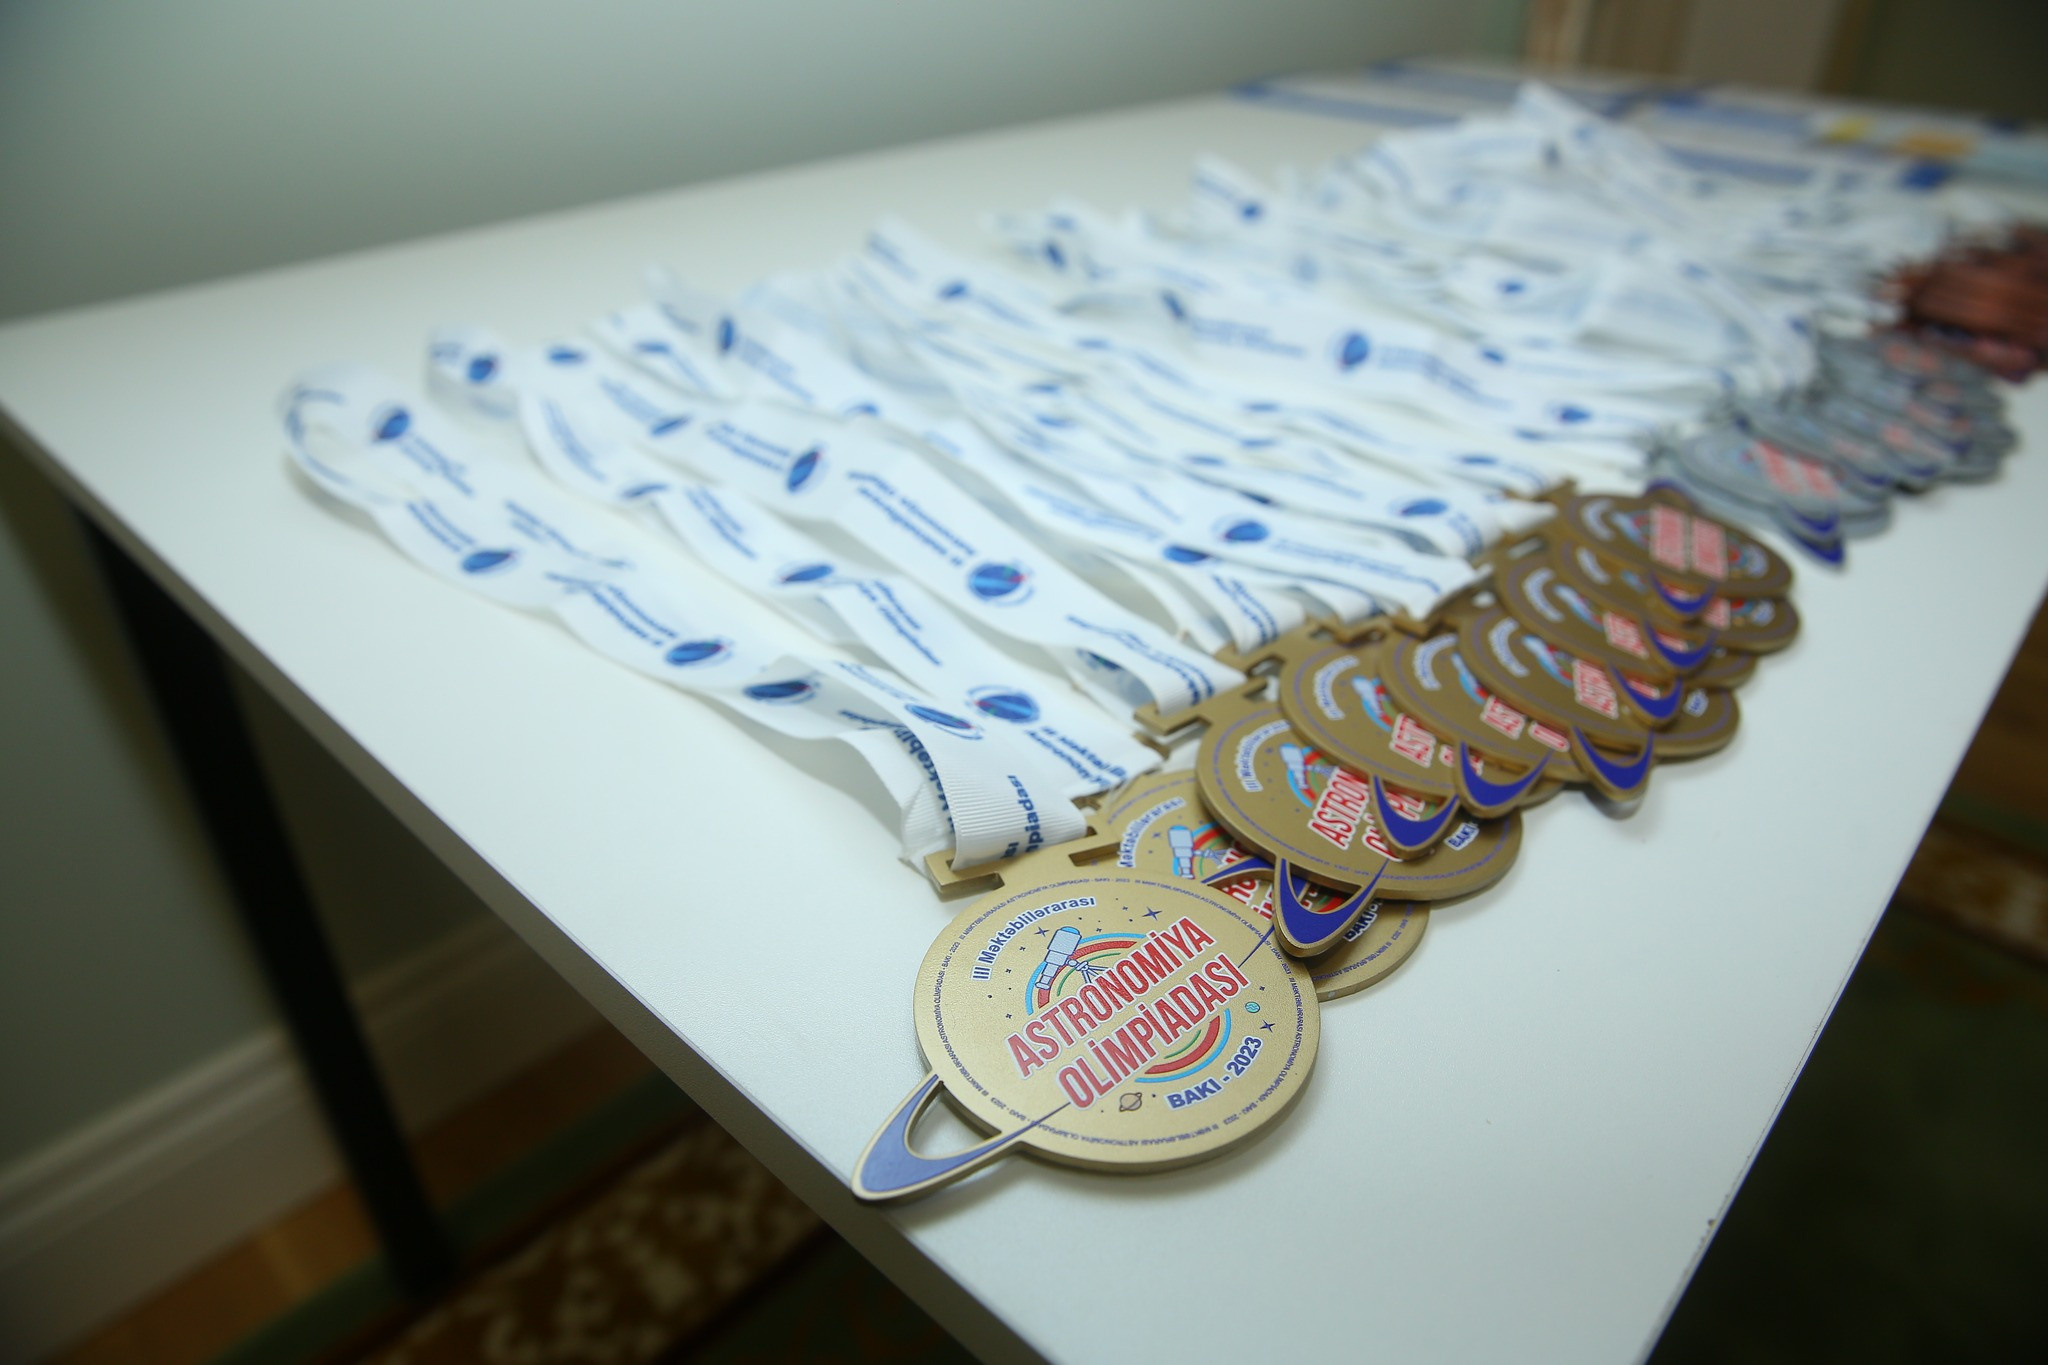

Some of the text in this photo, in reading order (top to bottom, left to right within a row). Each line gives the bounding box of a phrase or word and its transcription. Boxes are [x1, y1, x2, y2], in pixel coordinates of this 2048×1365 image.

[972, 897, 1095, 980] III Məktəblilərarası
[1006, 917, 1215, 1078] ASTRONOMİYA
[1058, 953, 1250, 1109] OLİMPİADASI
[1167, 1078, 1222, 1109] BAKI
[1226, 1036, 1262, 1077] 2023
